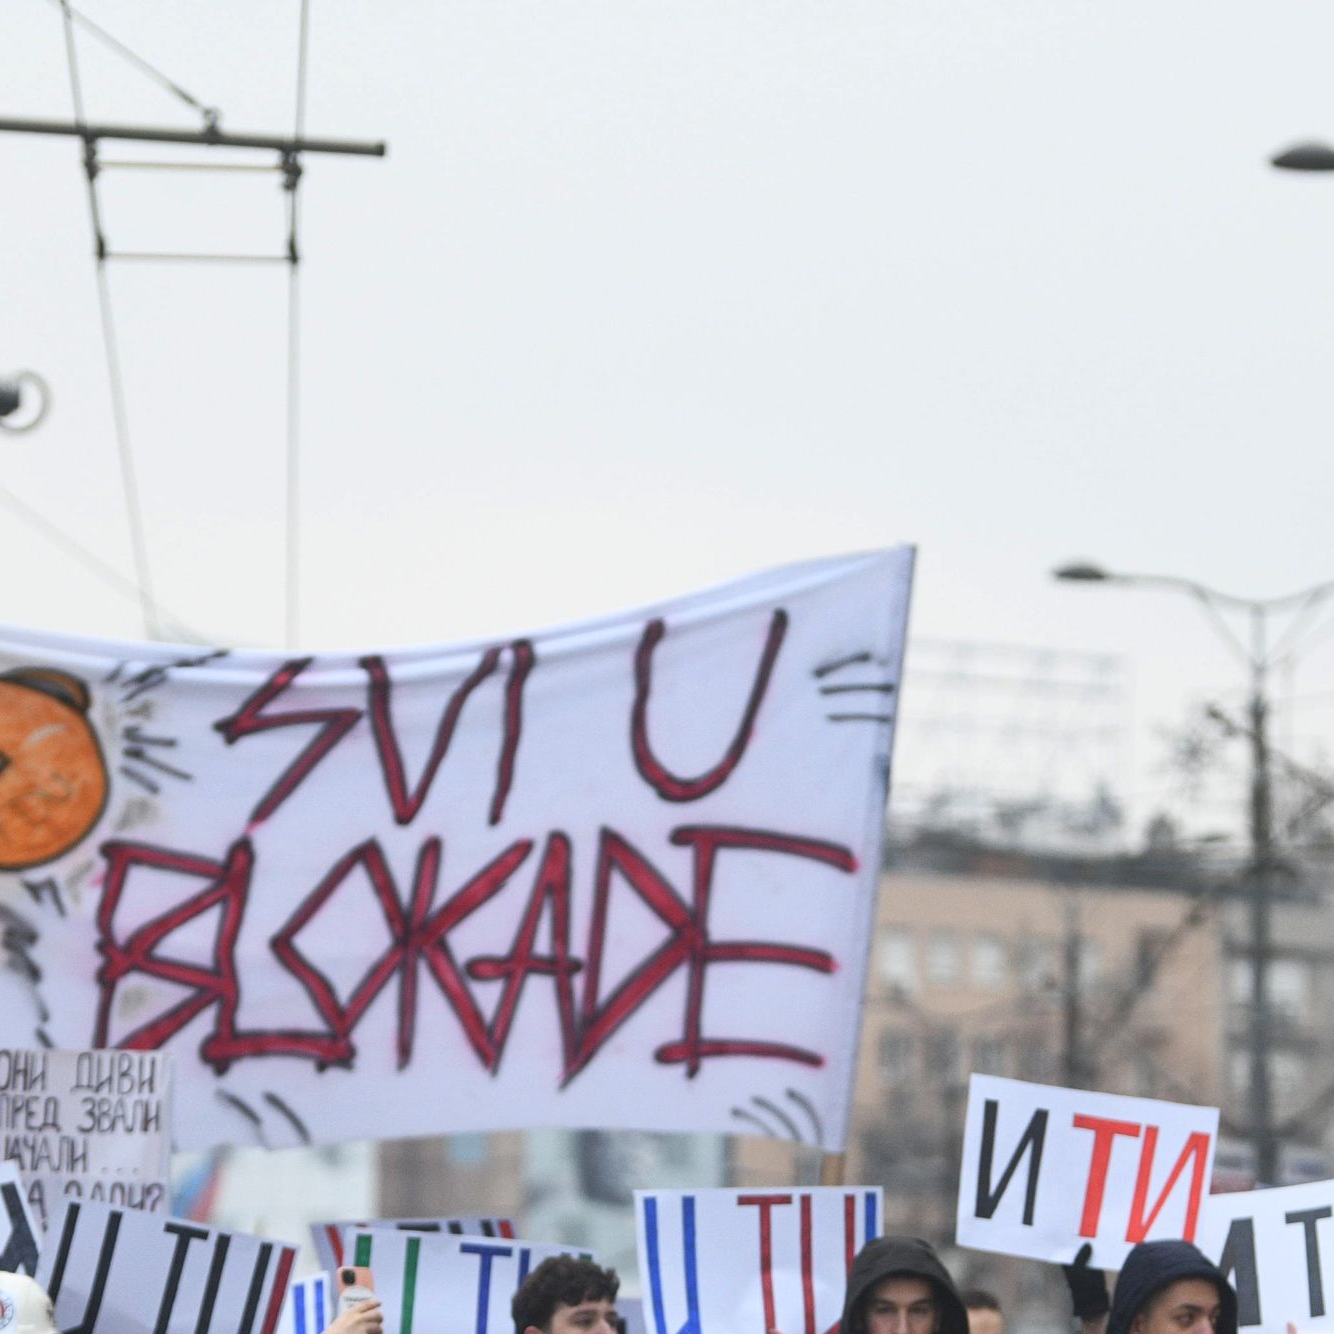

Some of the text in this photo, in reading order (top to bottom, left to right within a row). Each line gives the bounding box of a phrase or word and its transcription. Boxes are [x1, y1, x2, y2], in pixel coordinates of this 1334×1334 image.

[213, 608, 789, 834] SVI U
[95, 824, 859, 1090] BLOKADE
[69, 1051, 157, 1095] ДИВИ
[77, 1097, 162, 1134] ЗВАЛИ
[974, 1098, 1210, 1244] И ТИ
